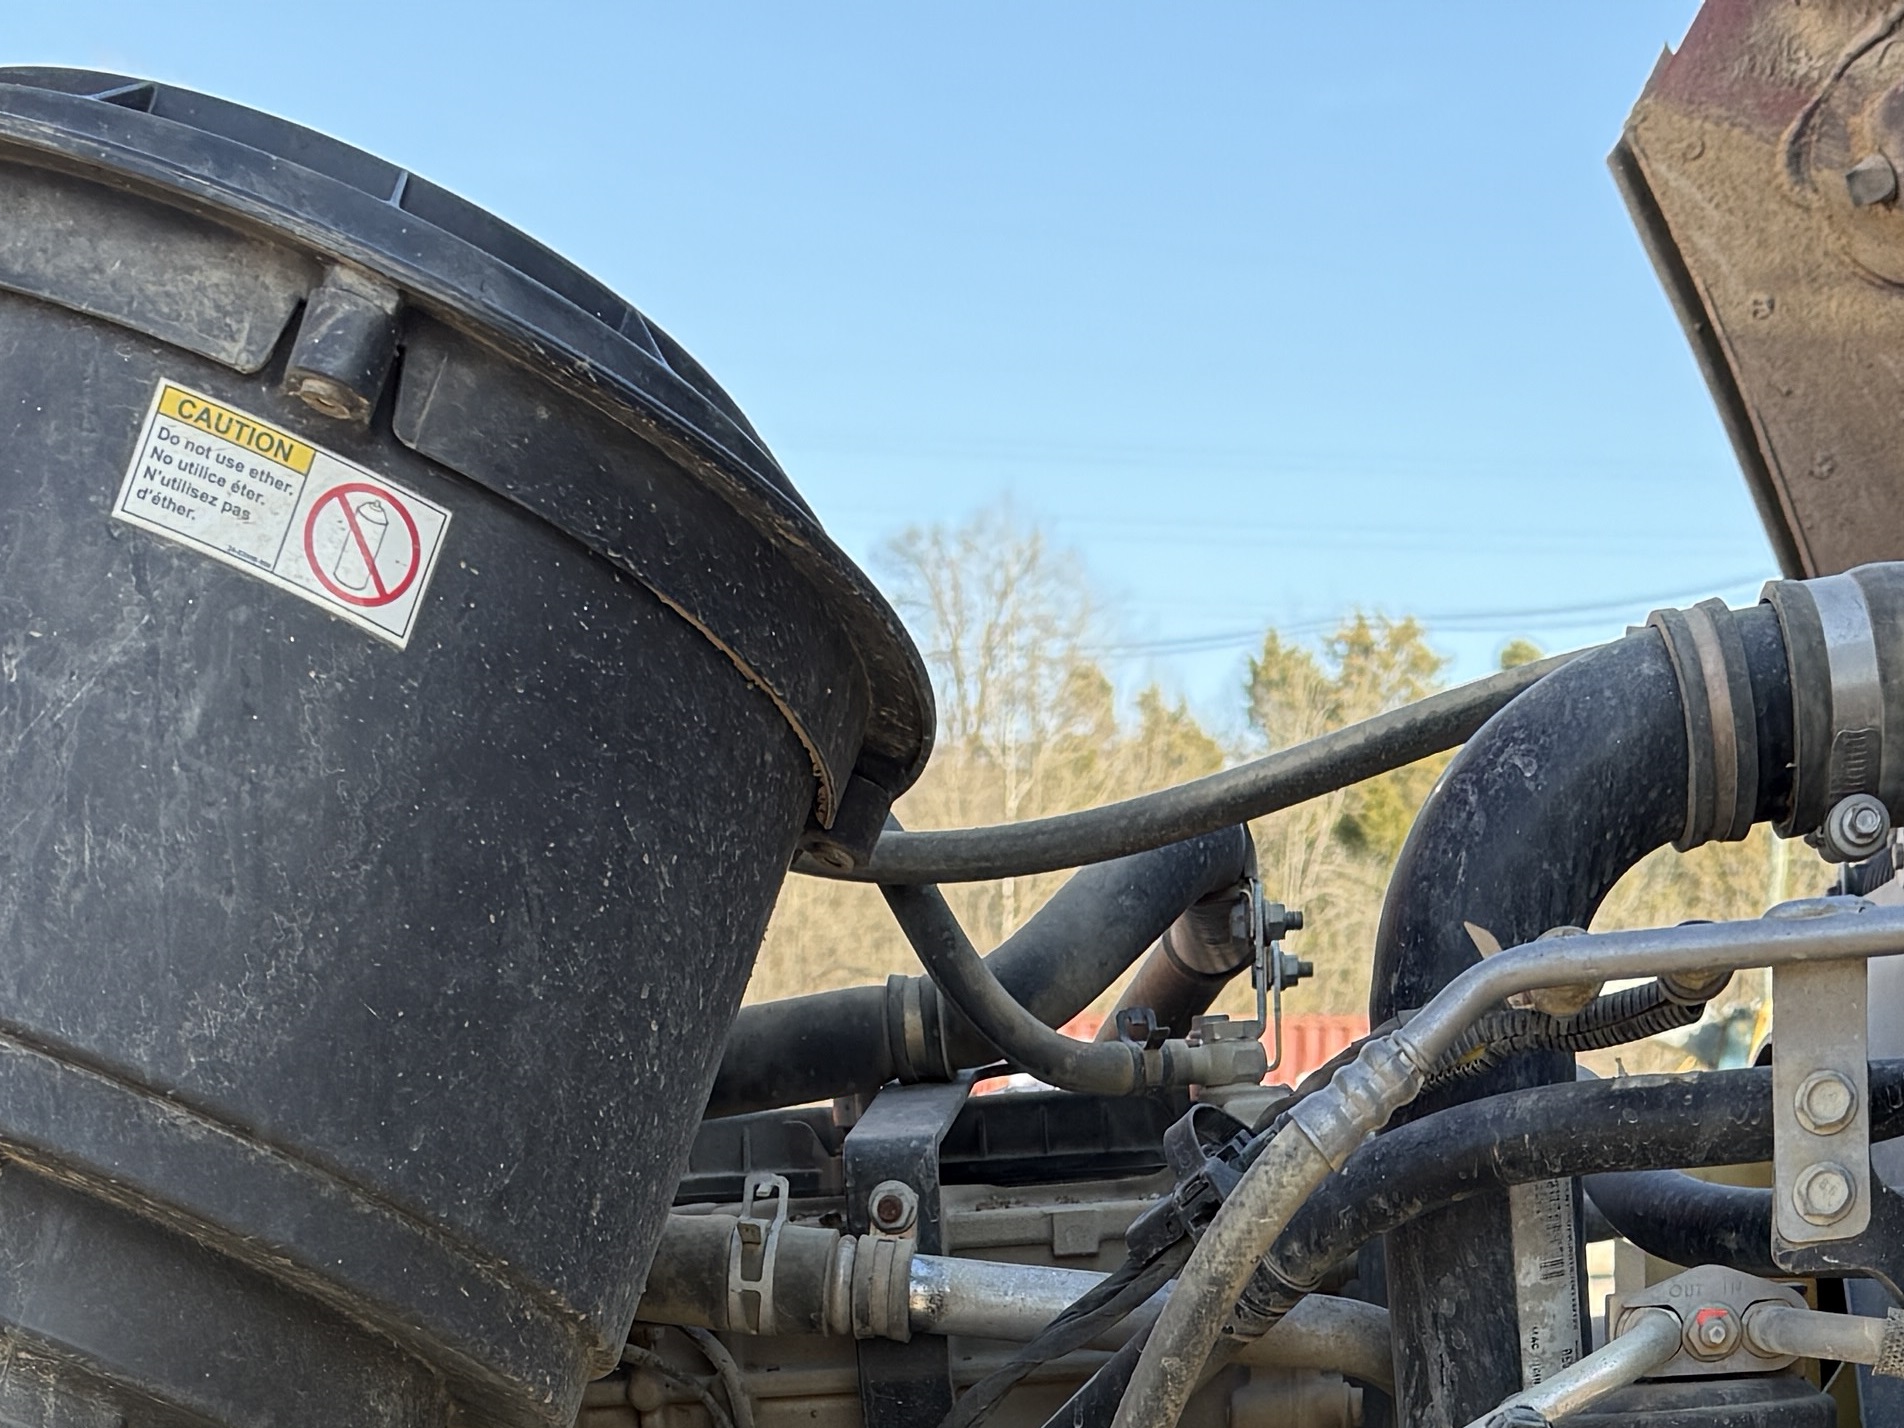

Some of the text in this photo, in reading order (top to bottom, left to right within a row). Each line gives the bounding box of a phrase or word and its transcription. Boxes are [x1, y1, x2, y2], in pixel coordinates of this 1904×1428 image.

[178, 399, 294, 462] CAUTION
[150, 446, 265, 506] No utilice éter.
[157, 426, 294, 496] Do not use ether.
[136, 488, 196, 520] d'éther.
[143, 466, 251, 520] N'utilisez pas
